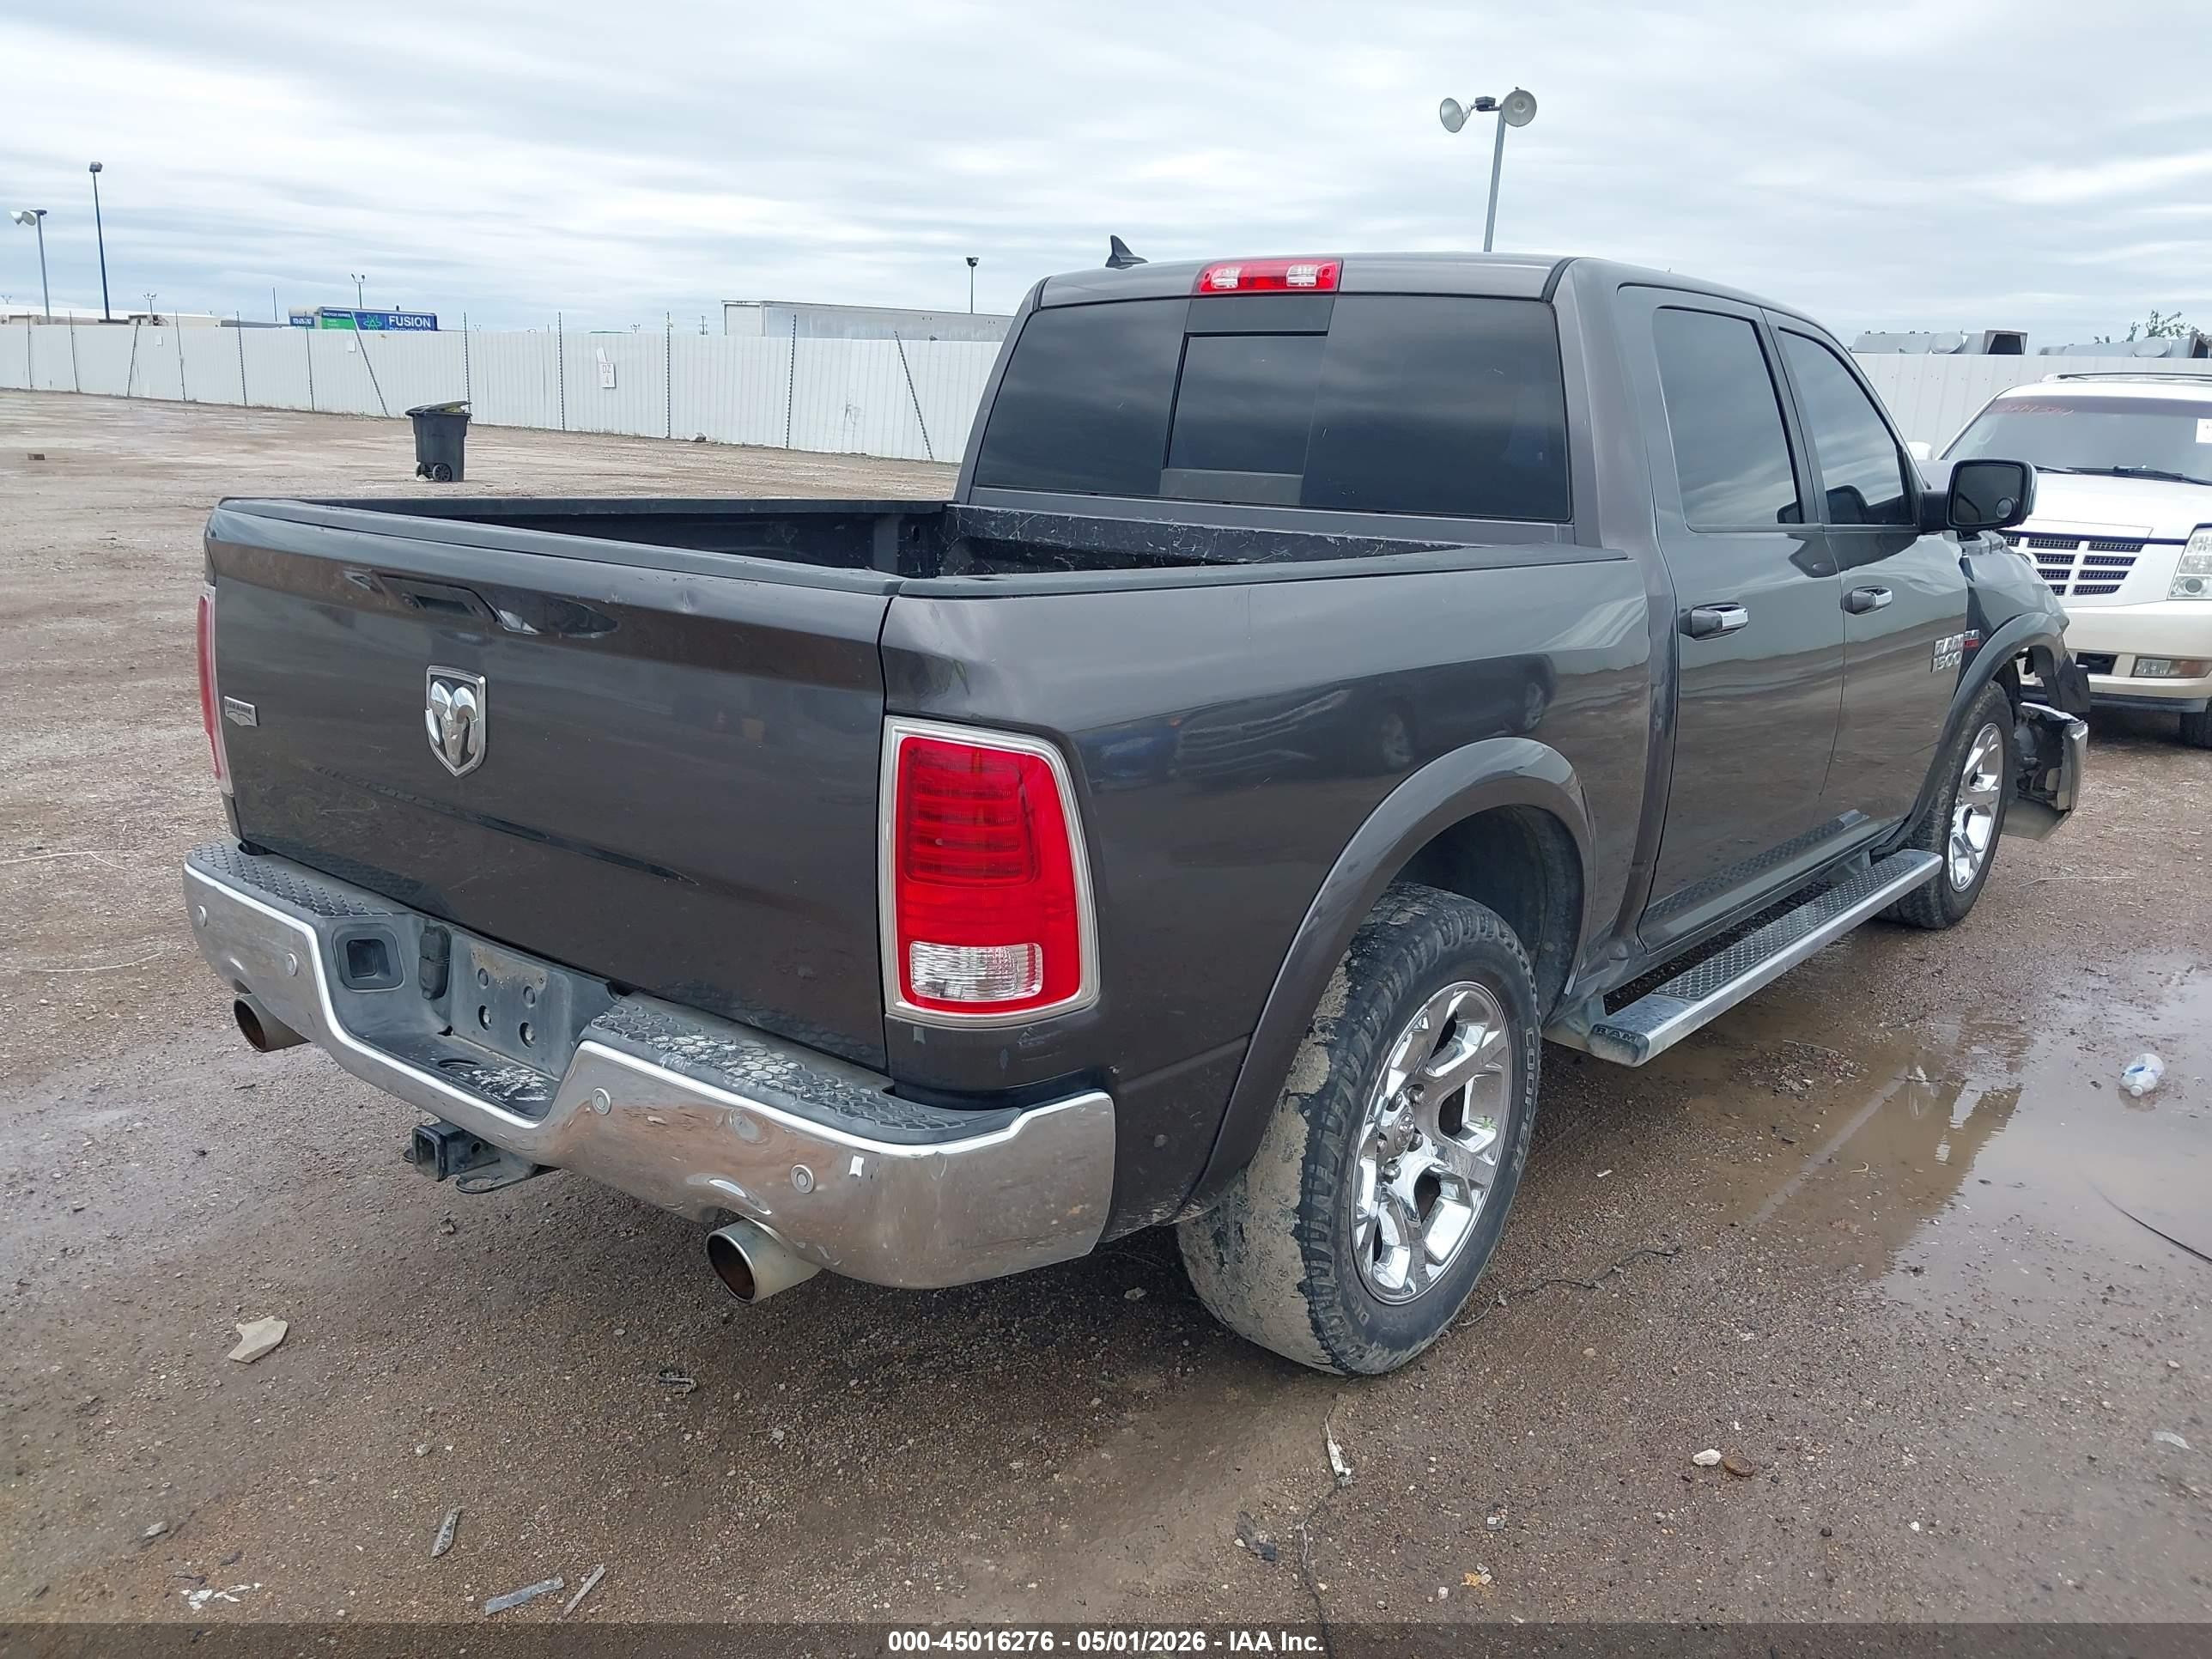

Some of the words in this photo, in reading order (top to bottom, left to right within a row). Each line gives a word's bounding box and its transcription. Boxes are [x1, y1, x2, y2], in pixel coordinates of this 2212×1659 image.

[389, 315, 431, 327] FUSION
[1931, 651, 1961, 673] 1500
[1511, 1027, 1535, 1171] COOPER
